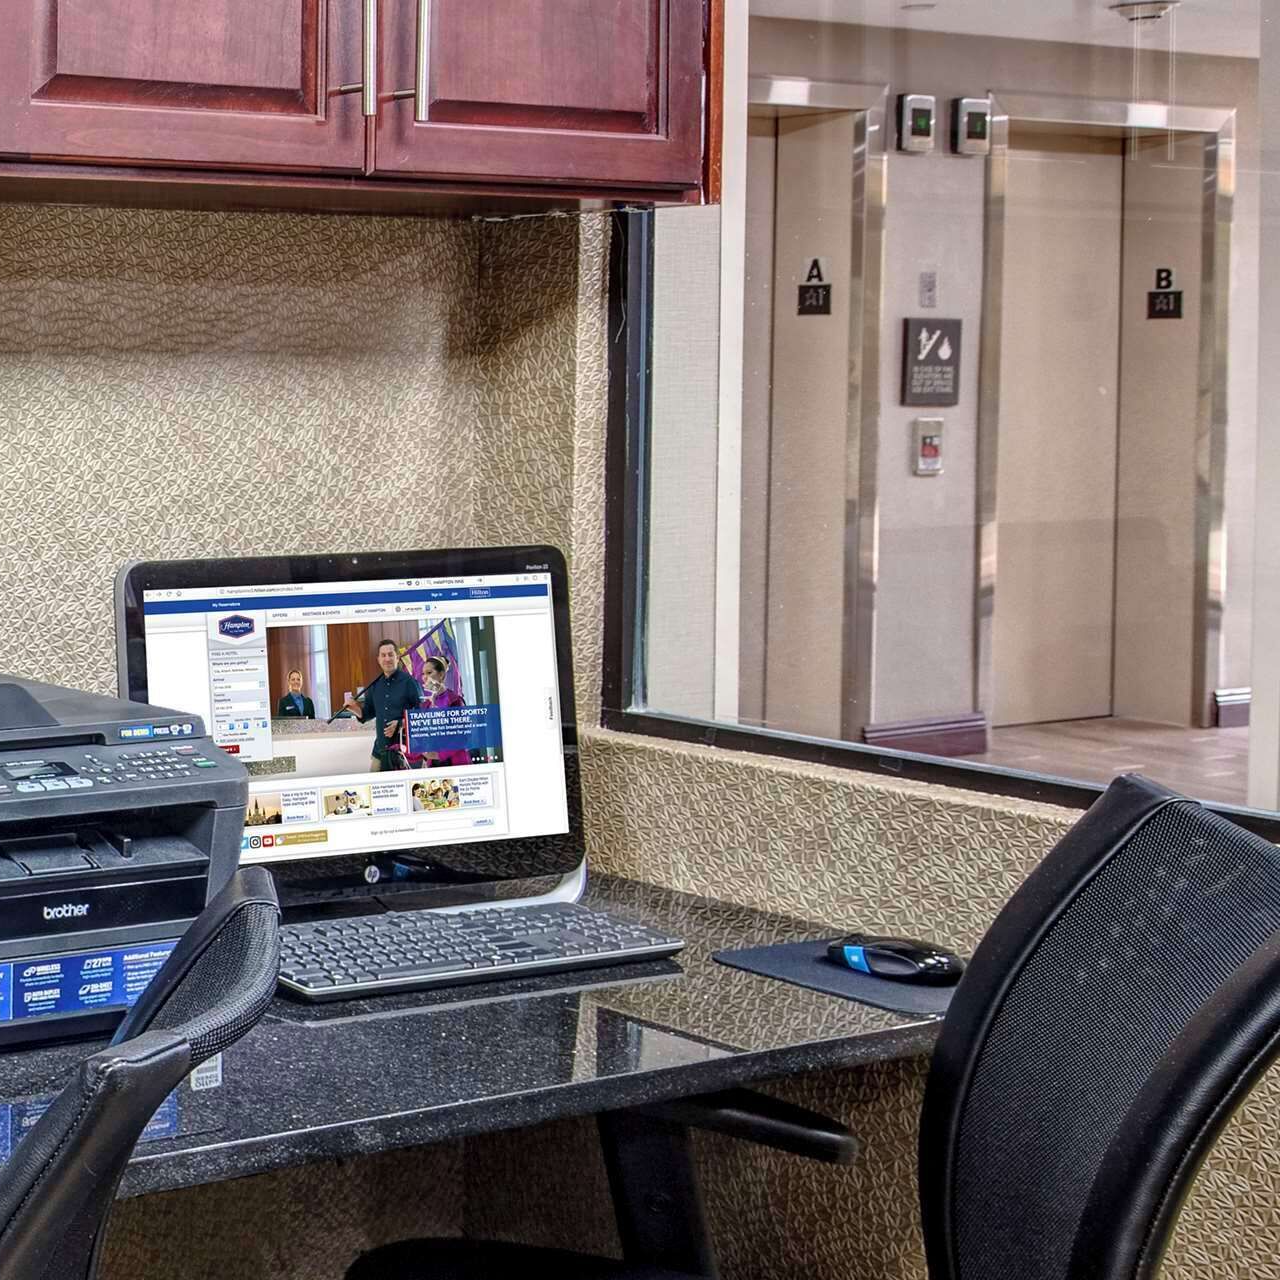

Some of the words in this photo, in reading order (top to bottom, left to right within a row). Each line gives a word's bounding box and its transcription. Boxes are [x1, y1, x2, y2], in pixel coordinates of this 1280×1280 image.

[806, 259, 824, 282] A
[1156, 269, 1172, 290] B
[223, 621, 252, 630] Hampton
[410, 711, 446, 720] TRAVELING
[461, 708, 488, 716] SPORTS?
[410, 719, 431, 727] WE'VE
[43, 904, 90, 920] brother
[124, 952, 150, 960] Additional
[92, 959, 102, 969] 27
